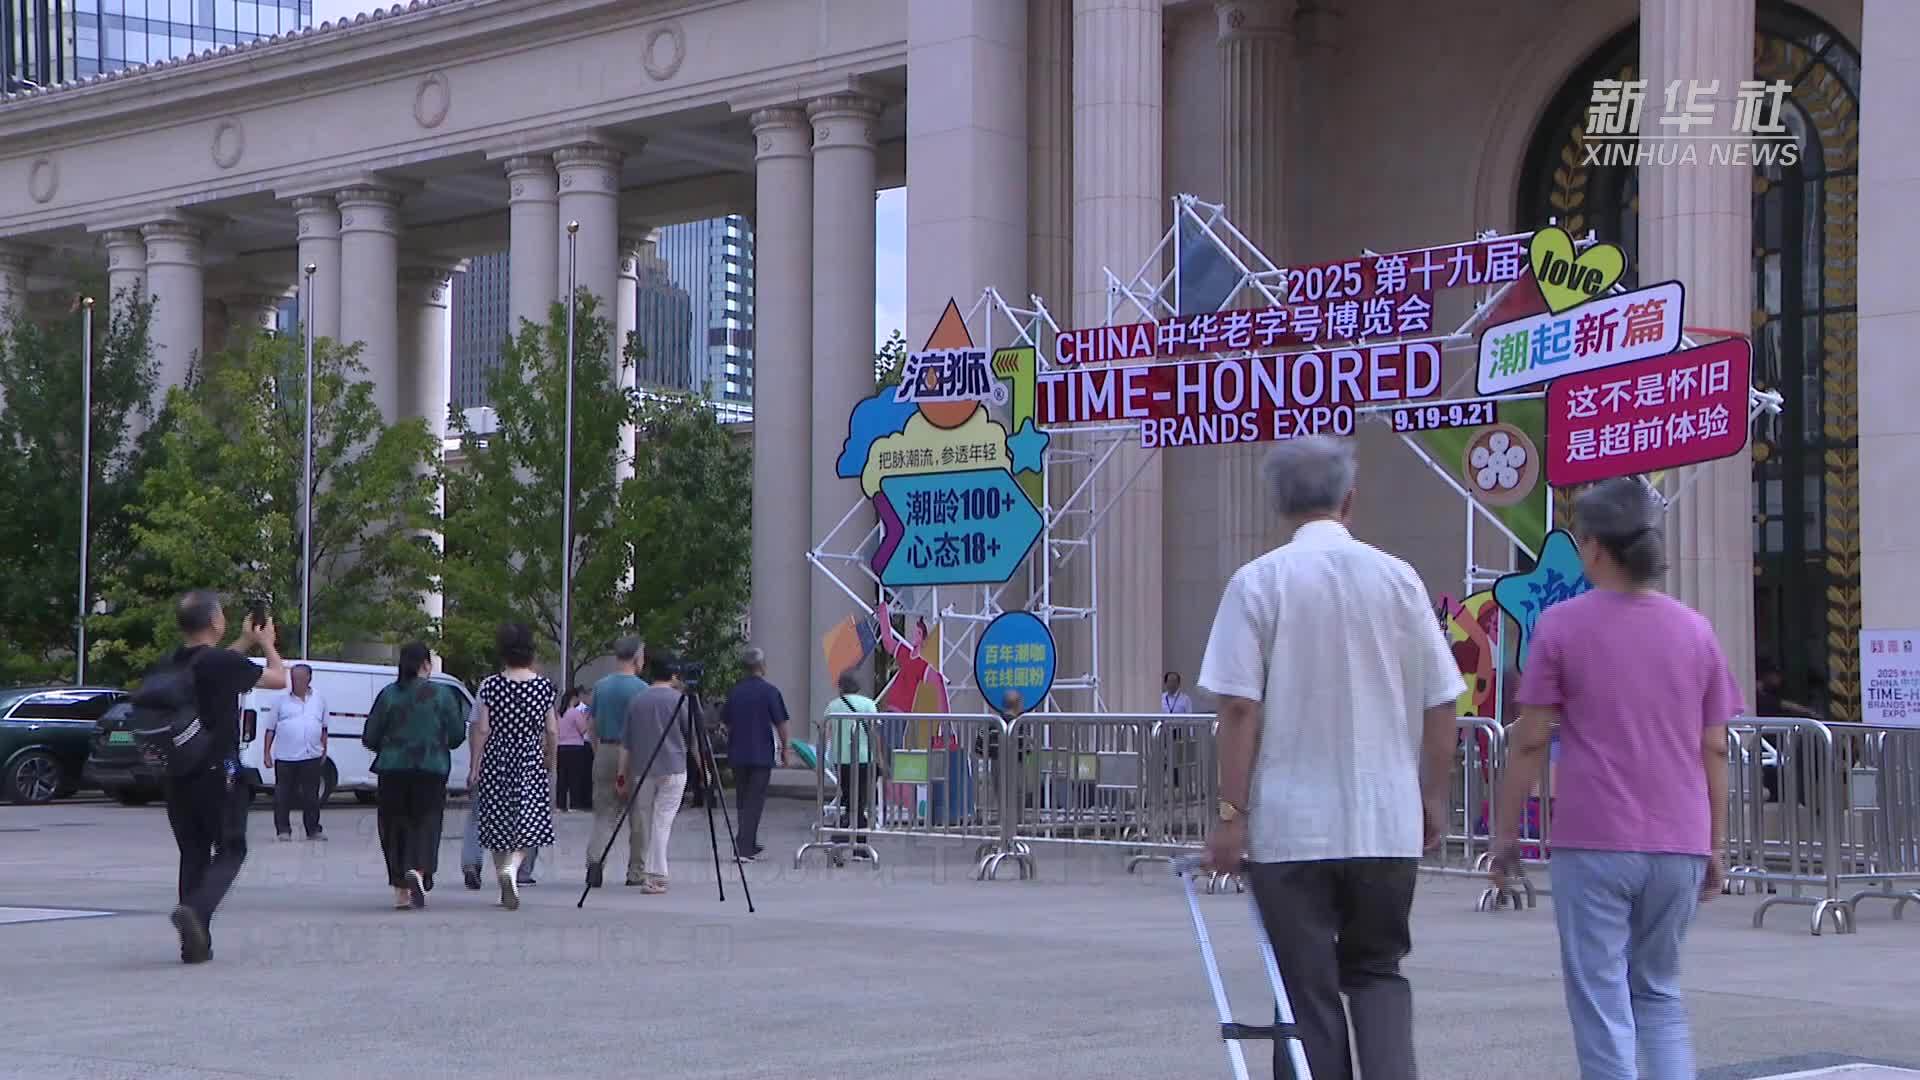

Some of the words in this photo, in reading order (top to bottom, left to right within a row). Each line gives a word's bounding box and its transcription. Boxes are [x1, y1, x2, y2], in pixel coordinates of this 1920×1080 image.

[1288, 260, 1362, 303] 2025
[1374, 241, 1521, 298] 第十九届
[1538, 250, 1604, 296] love
[1055, 324, 1153, 365] CHINA
[1157, 295, 1432, 356] 中华老字号博览会
[1488, 298, 1668, 380] 潮起新篇
[898, 350, 991, 399] 海狮
[1037, 341, 1442, 424] TIME-HONORED
[1566, 359, 1731, 420] 这不是怀旧
[1140, 409, 1260, 449] BRANDS
[1273, 406, 1355, 440] EXPO
[1394, 401, 1495, 432] 9.19-9.21
[1566, 403, 1730, 464] 是超前体验
[905, 487, 1016, 527] 潮龄100+
[906, 532, 1001, 569] 心态18+
